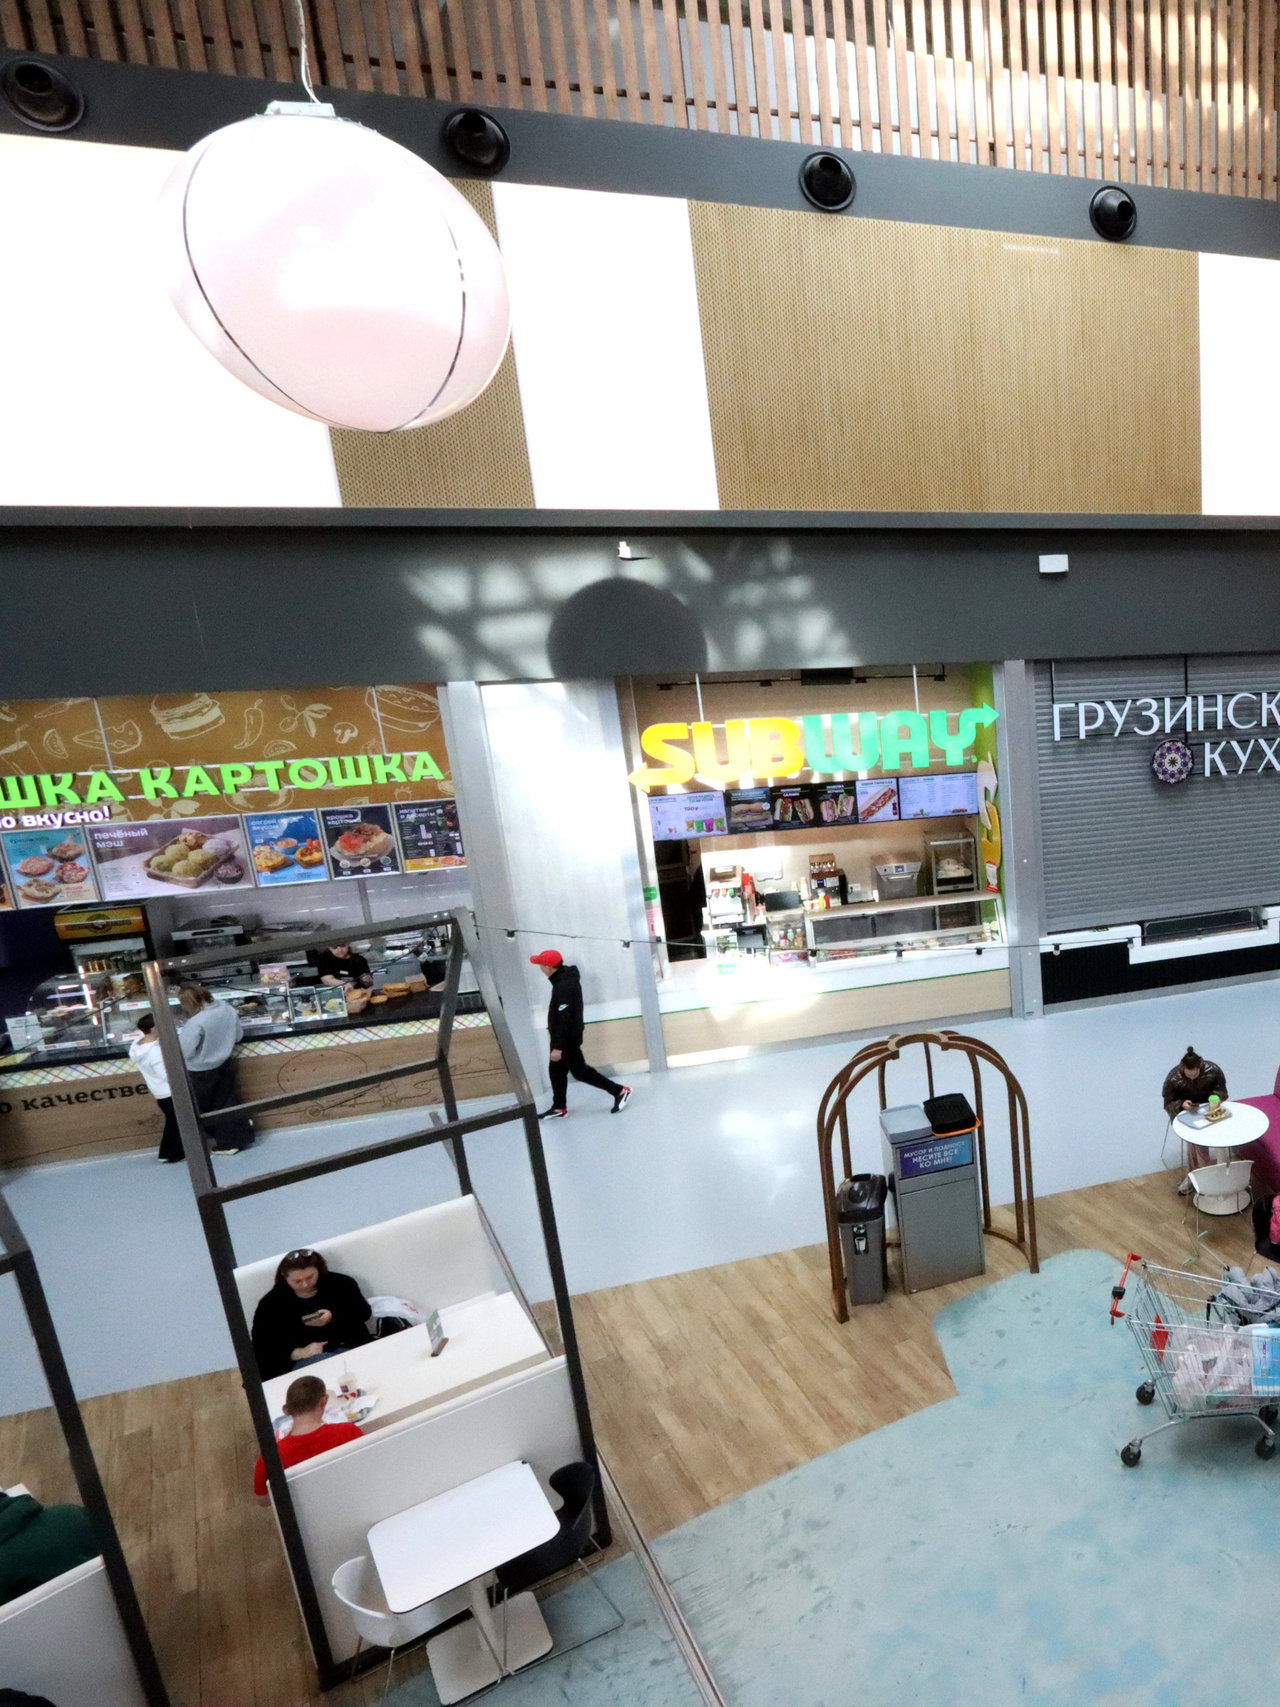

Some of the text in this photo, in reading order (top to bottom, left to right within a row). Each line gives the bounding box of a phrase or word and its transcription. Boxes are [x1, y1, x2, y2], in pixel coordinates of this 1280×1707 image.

[628, 702, 1001, 793] SUBWAY
[138, 751, 445, 800] КАРТОШКА
[21, 805, 110, 829] вкусно!
[94, 827, 148, 840] печёный
[96, 839, 124, 849] мэш
[21, 1083, 150, 1111] качестве
[904, 1149, 927, 1159] МУСОР
[912, 1152, 942, 1163] НЕСИТЕ
[919, 1161, 931, 1169] КО
